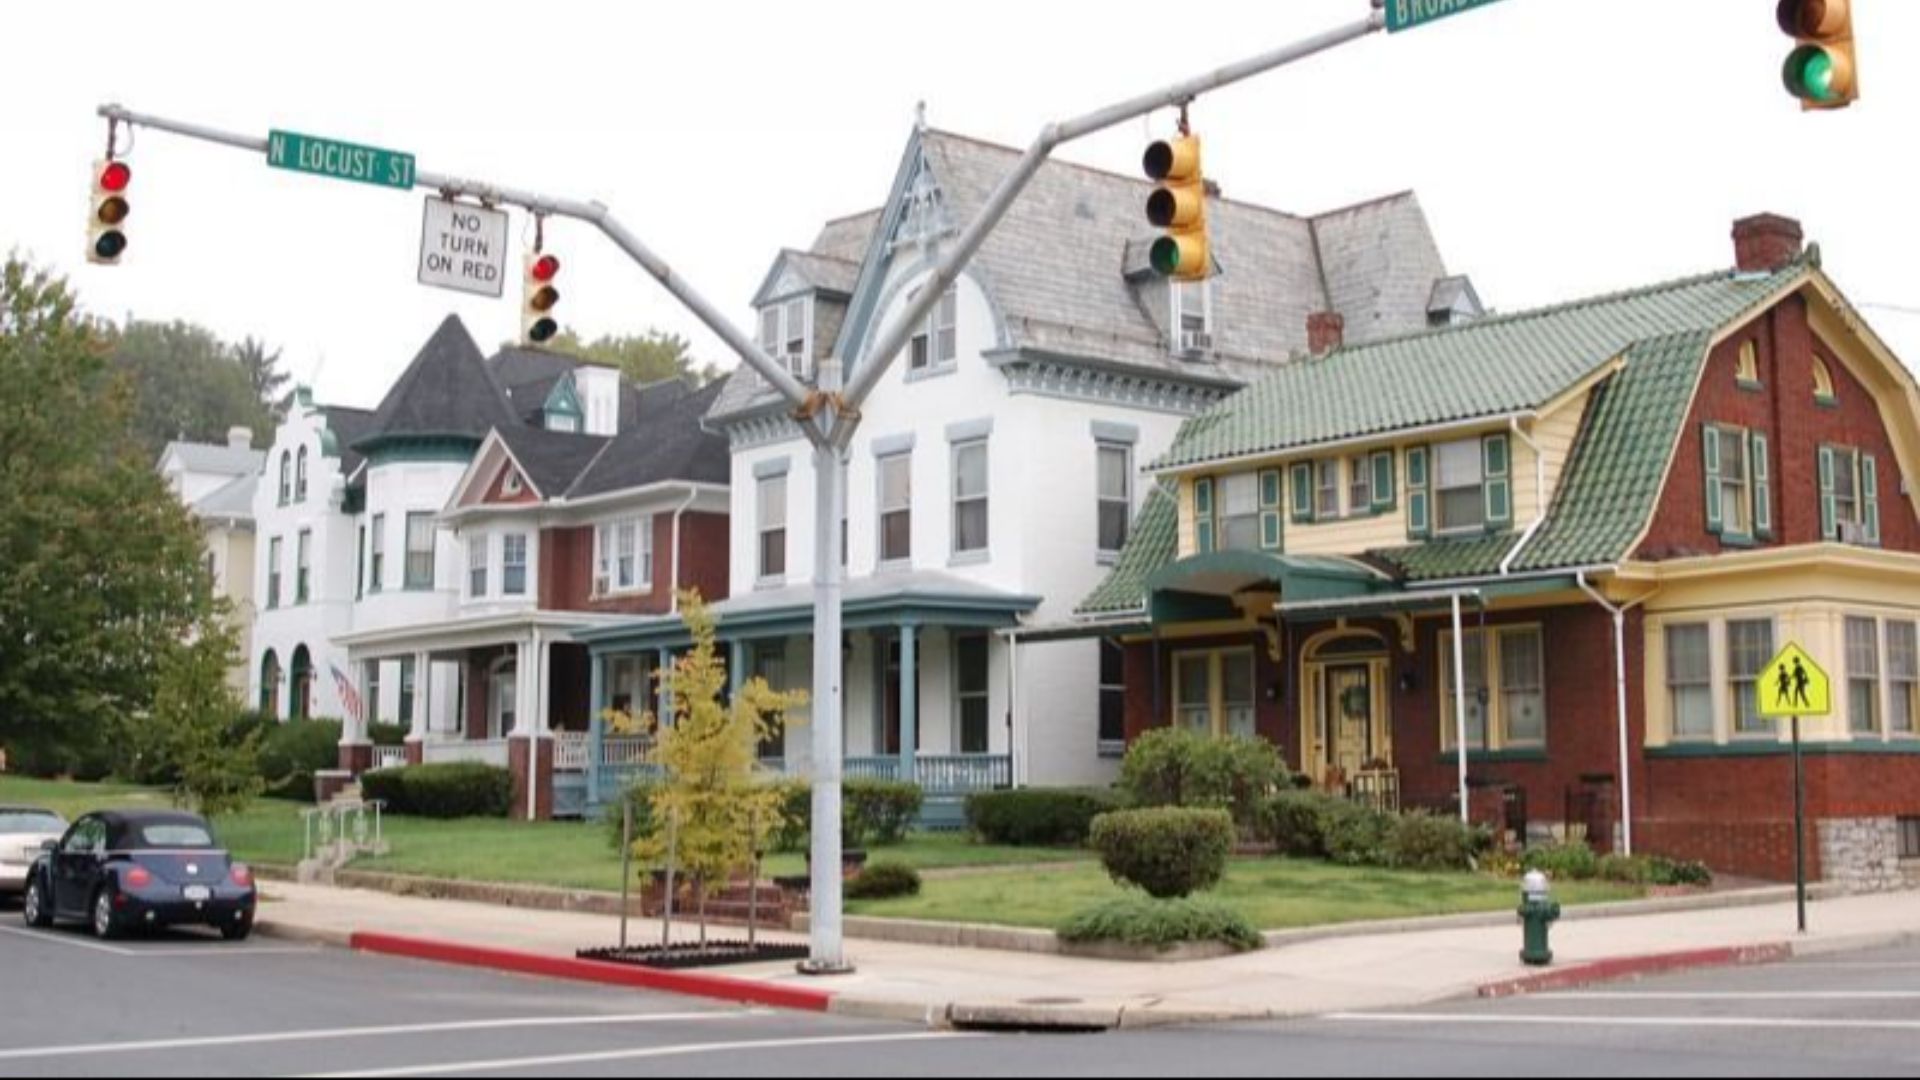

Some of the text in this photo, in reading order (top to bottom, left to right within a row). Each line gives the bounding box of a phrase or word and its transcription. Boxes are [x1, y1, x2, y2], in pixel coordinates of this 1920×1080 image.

[271, 134, 413, 184] N LOCUST ST
[452, 212, 481, 233] NO
[441, 232, 488, 258] TURN
[427, 252, 497, 282] ON RED
